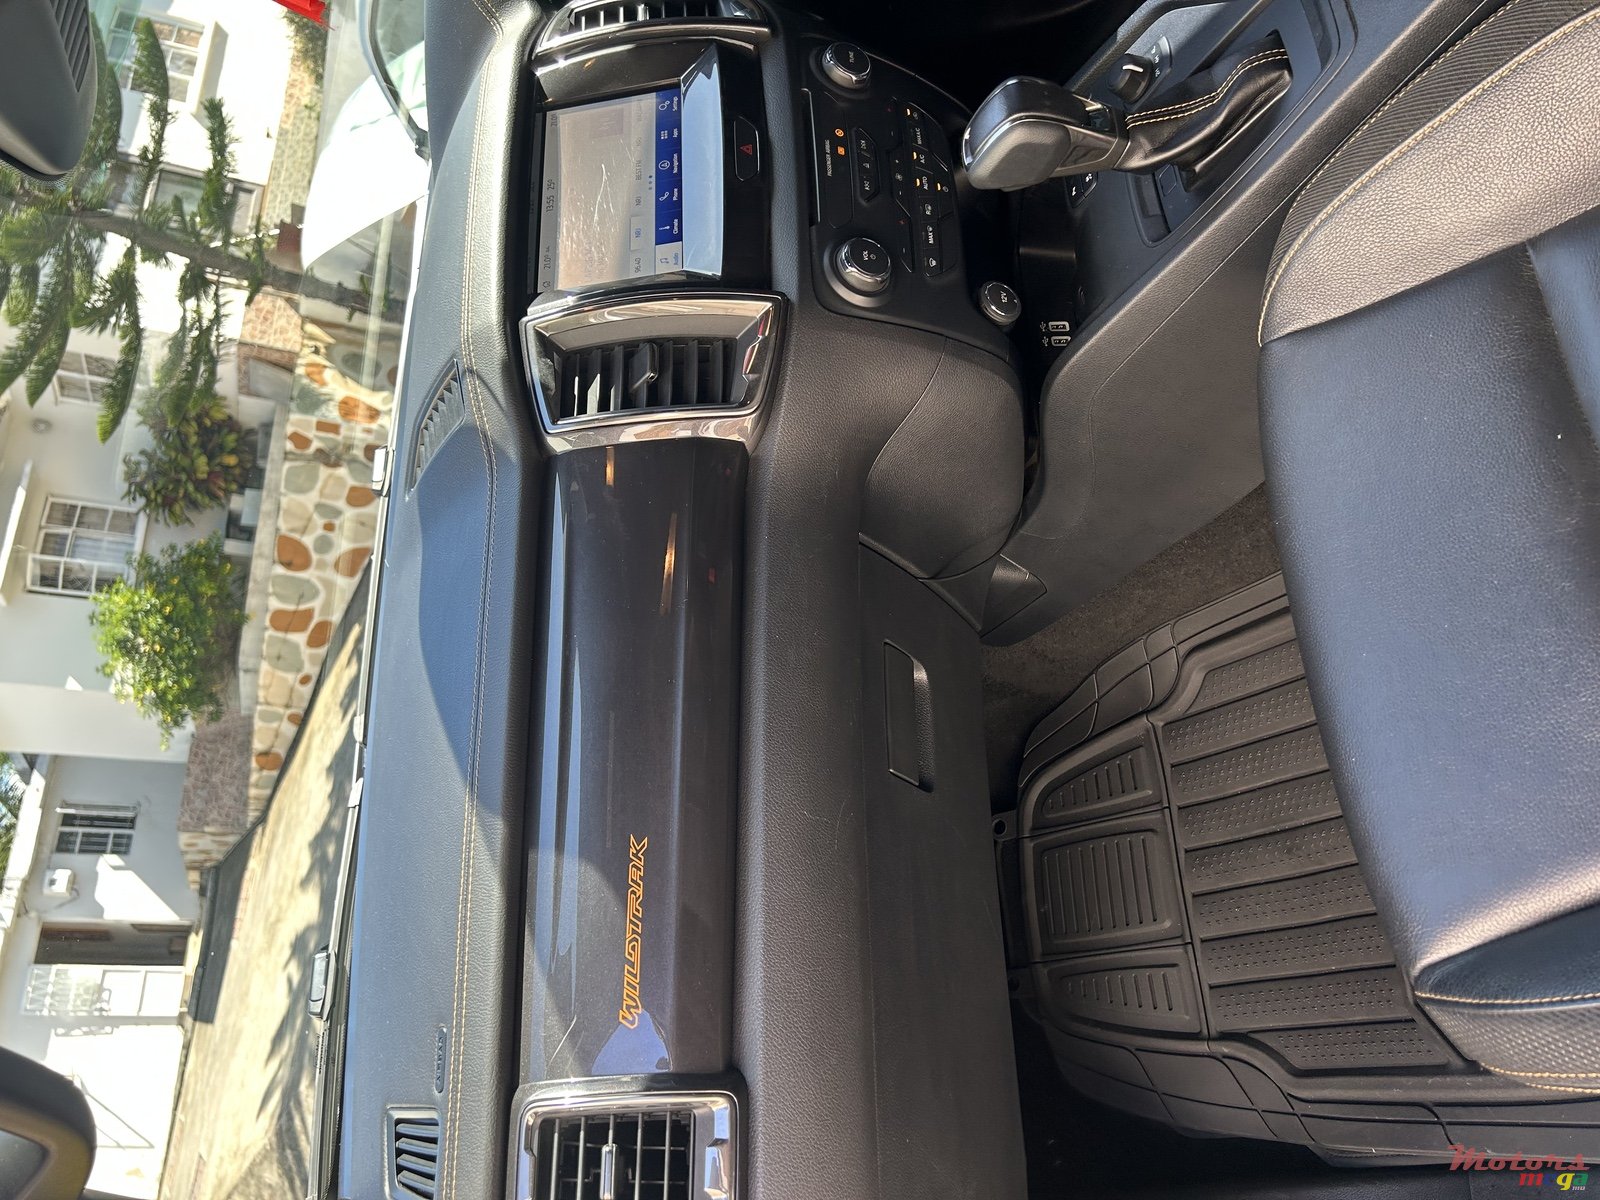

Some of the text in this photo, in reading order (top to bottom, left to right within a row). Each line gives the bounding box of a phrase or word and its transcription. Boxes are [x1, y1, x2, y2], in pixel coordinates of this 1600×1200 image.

[546, 195, 554, 212] 13:55
[1000, 290, 1008, 303] 12V
[618, 834, 648, 1029] WILDTRAK
